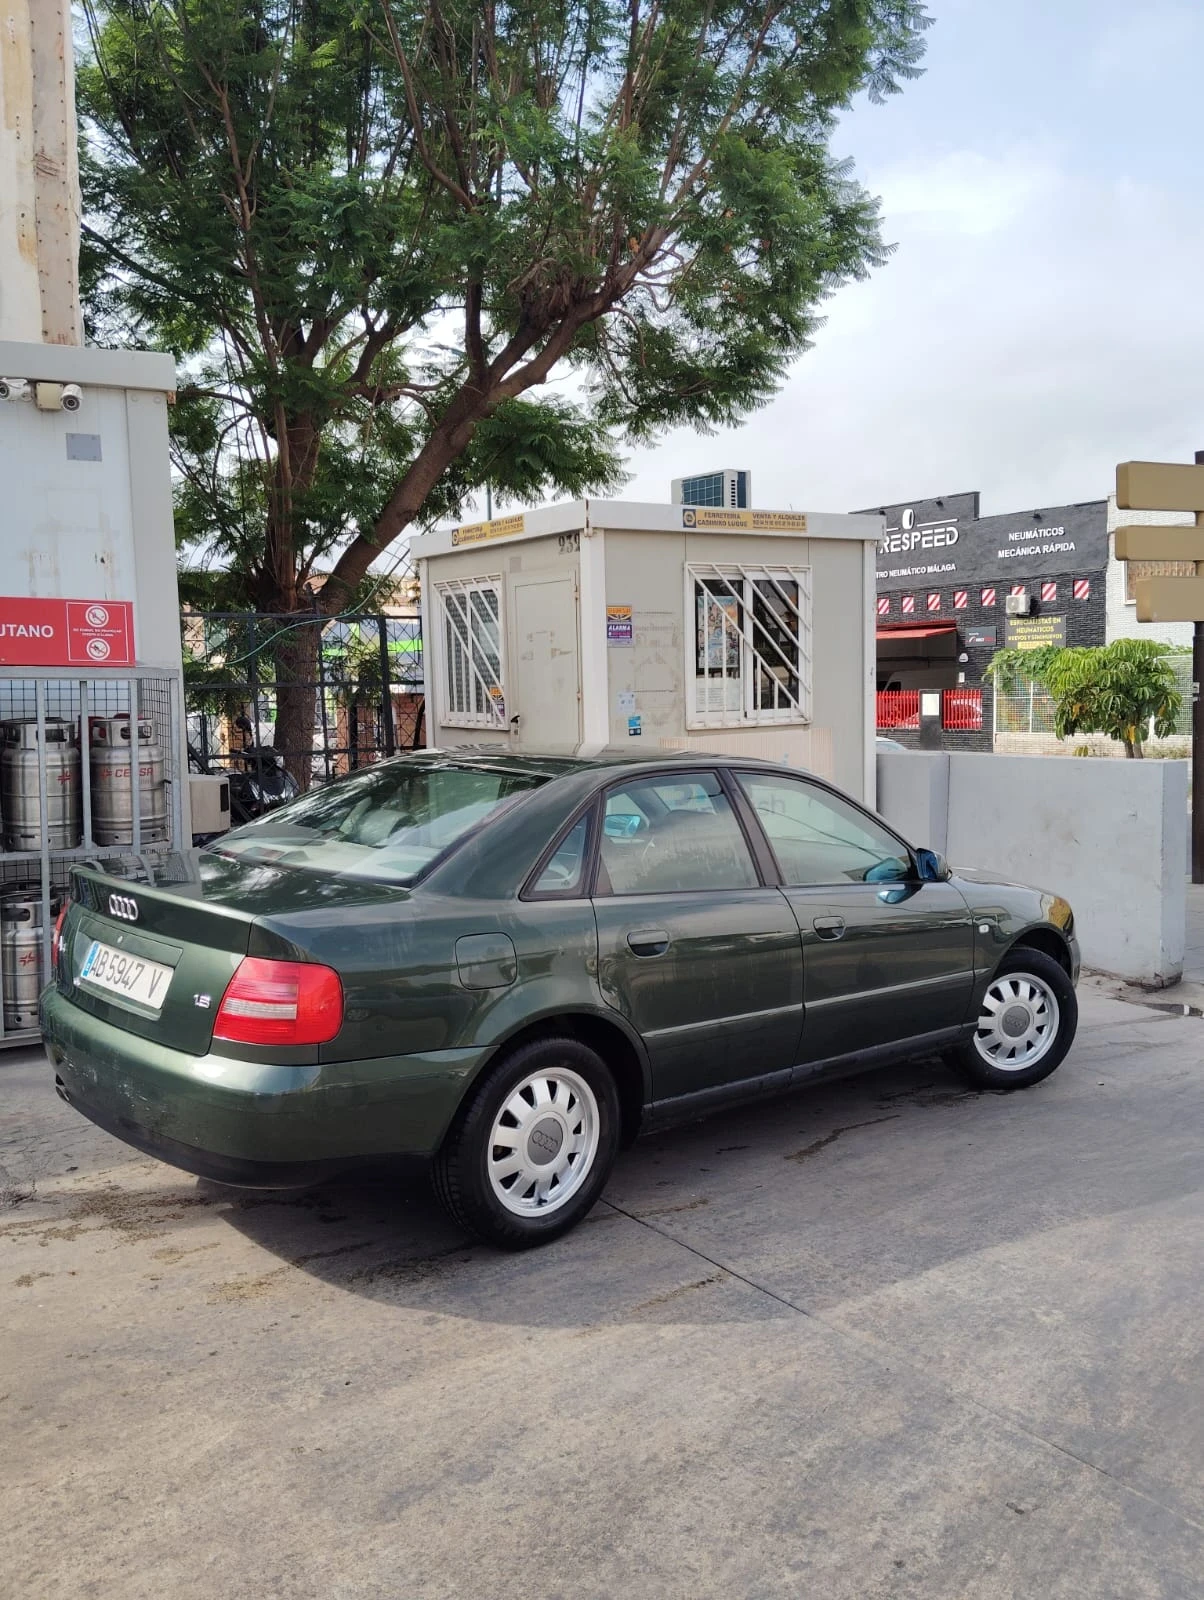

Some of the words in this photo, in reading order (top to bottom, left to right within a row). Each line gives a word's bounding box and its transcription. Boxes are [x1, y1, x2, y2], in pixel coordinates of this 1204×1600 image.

[1008, 526, 1065, 541] NEUMÁTICOS
[998, 545, 1041, 558] MECÁNICA
[1042, 541, 1076, 554] RÁPIDA
[889, 566, 926, 577] NEUMÁTICO
[927, 563, 957, 574] MÁLAGA
[115, 768, 153, 778] CESA
[106, 954, 145, 990] 5947
[148, 968, 163, 999] V
